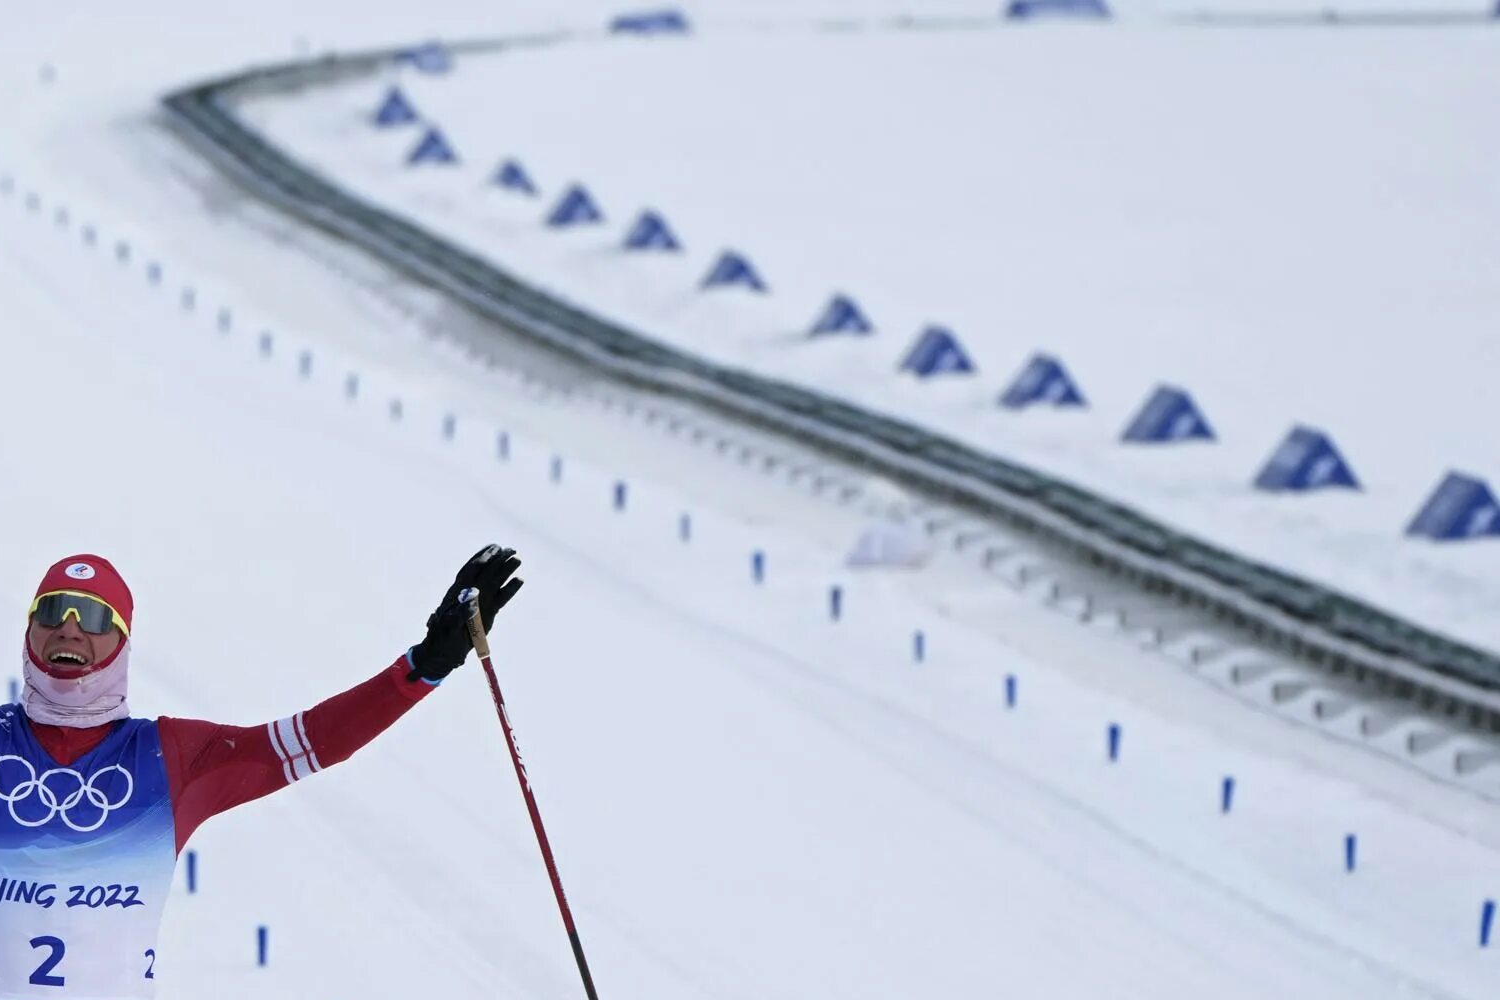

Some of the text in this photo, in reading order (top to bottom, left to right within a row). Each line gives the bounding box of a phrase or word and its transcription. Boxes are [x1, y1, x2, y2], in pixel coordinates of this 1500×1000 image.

[66, 884, 145, 908] 2022
[29, 935, 66, 987] 2
[144, 948, 156, 979] 2
